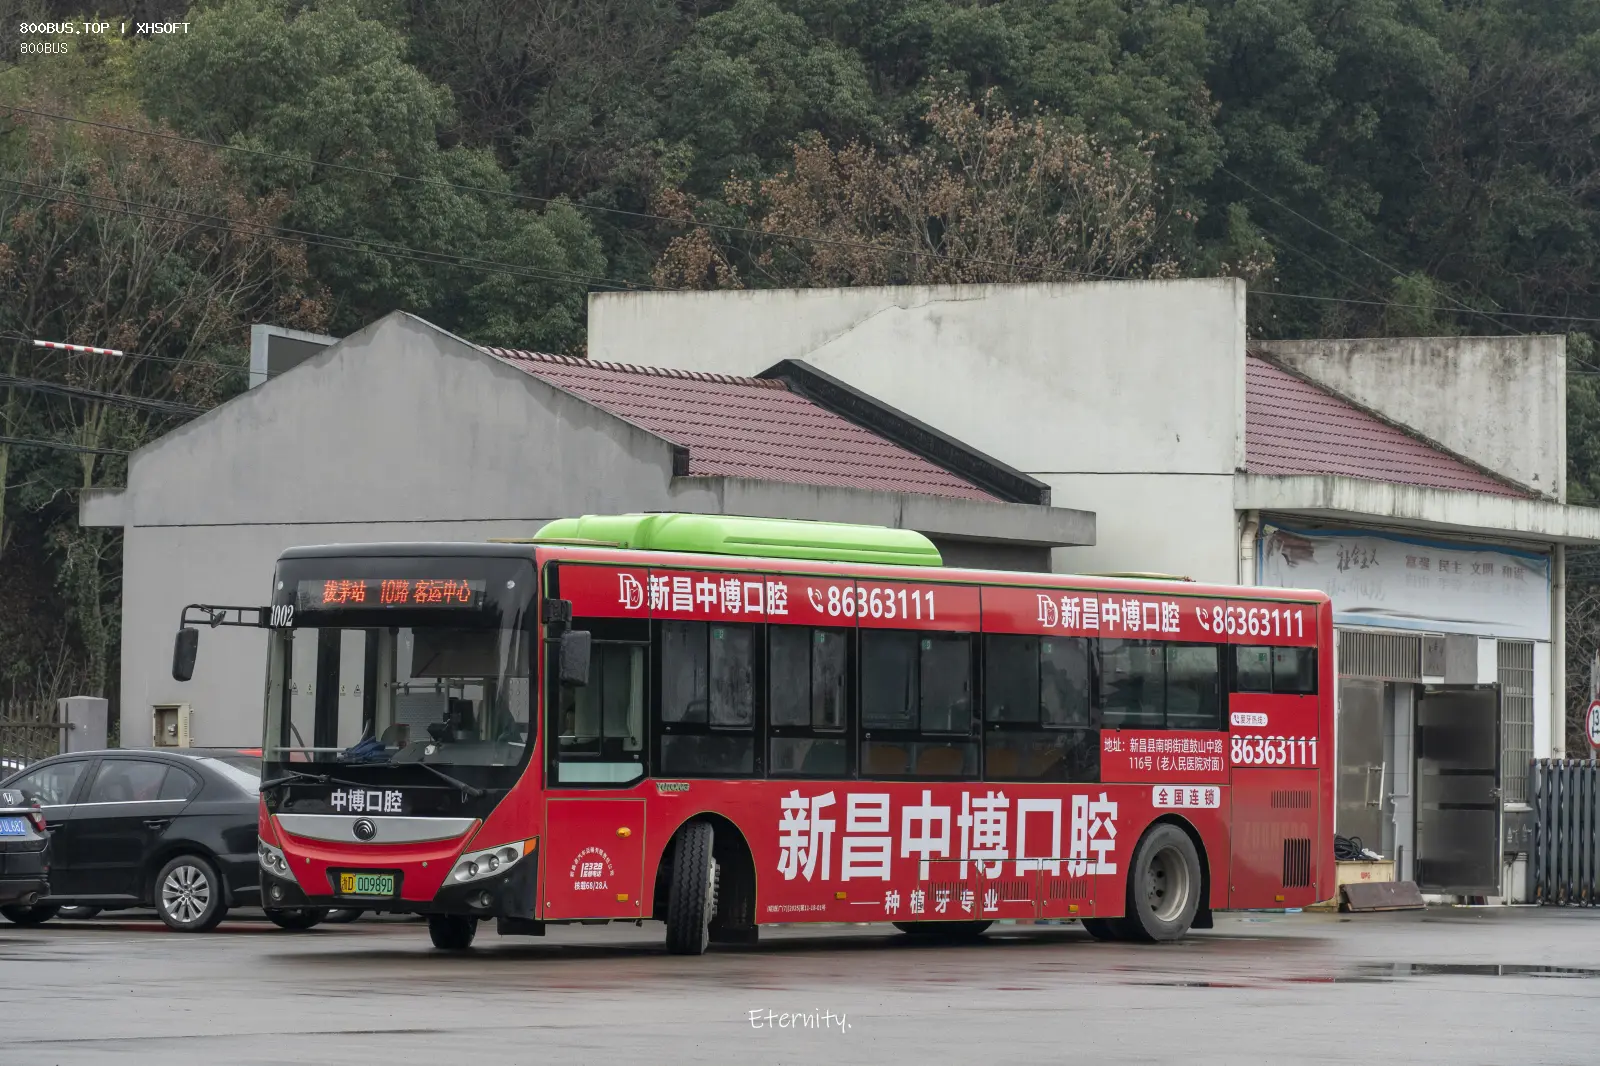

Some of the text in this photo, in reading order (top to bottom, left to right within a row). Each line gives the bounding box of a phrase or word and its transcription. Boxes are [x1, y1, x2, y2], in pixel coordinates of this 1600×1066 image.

[1405, 555, 1527, 582] 富强 民主 文明 和谐
[380, 579, 410, 604] 10路
[413, 579, 472, 604] 客运中心
[647, 575, 936, 620] 新昌中博口腔 86363111
[270, 604, 294, 627] 1002
[1060, 596, 1303, 638] 新昌中博口腔 86363111
[1231, 734, 1317, 766] 86363111
[330, 788, 403, 814] 中博口腔
[1158, 788, 1215, 806] 全国连锁
[776, 789, 1120, 882] 新昌中博口腔
[581, 862, 604, 878] 12328
[884, 889, 999, 915] 种植牙专业
